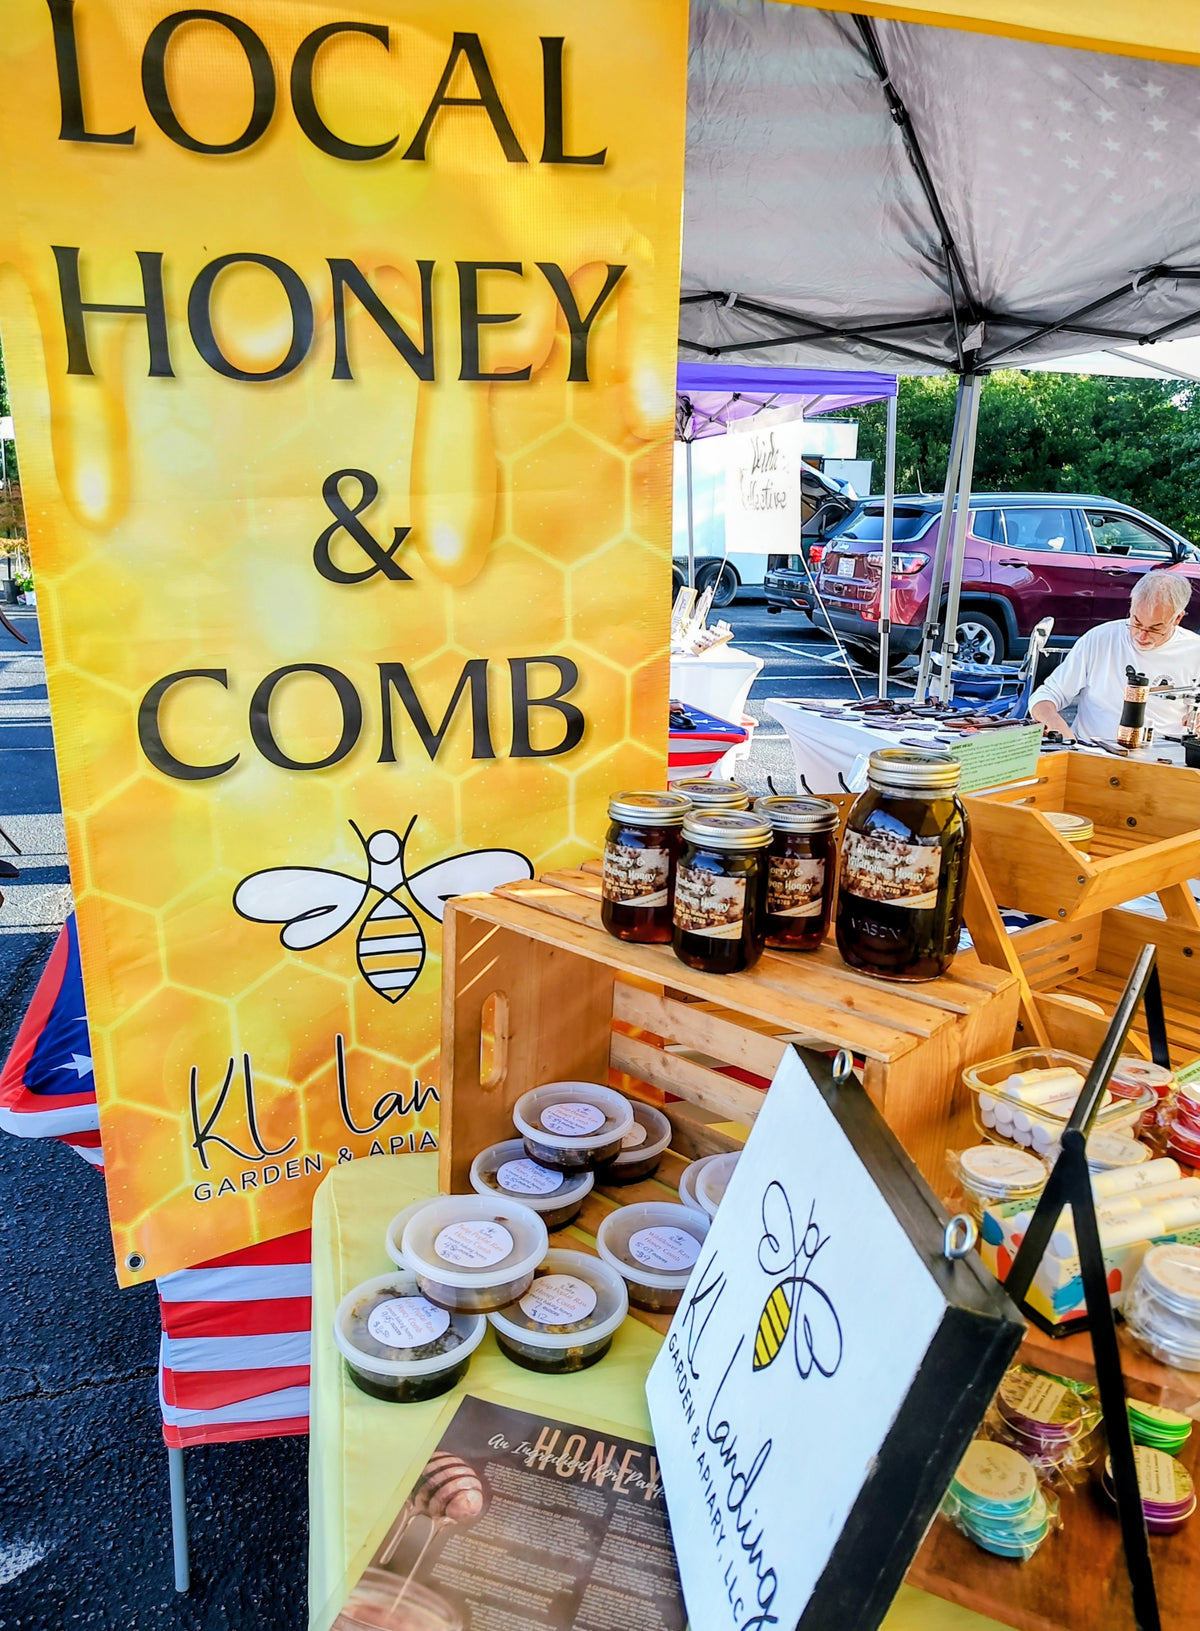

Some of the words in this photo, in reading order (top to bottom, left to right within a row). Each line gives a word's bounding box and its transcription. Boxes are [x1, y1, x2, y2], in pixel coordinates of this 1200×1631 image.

[47, 0, 608, 166] LOCAL
[50, 245, 628, 383] HONEY
[312, 468, 414, 585] &
[137, 655, 586, 782] COMB
[628, 869, 656, 884] Honey
[785, 880, 812, 893] Honey
[857, 843, 903, 865] Blueberry
[894, 867, 926, 883] Honey
[700, 896, 730, 914] Honey
[194, 1153, 322, 1201] GARDEN
[337, 1147, 353, 1165] &
[370, 1130, 438, 1157] APIA
[488, 1433, 510, 1449] An
[511, 1441, 595, 1475] Ingredient
[592, 1460, 622, 1483] for
[527, 1426, 662, 1501] HONEY
[668, 1333, 695, 1426] GARDEN
[690, 1425, 700, 1446] &
[723, 1559, 743, 1623] LLC
